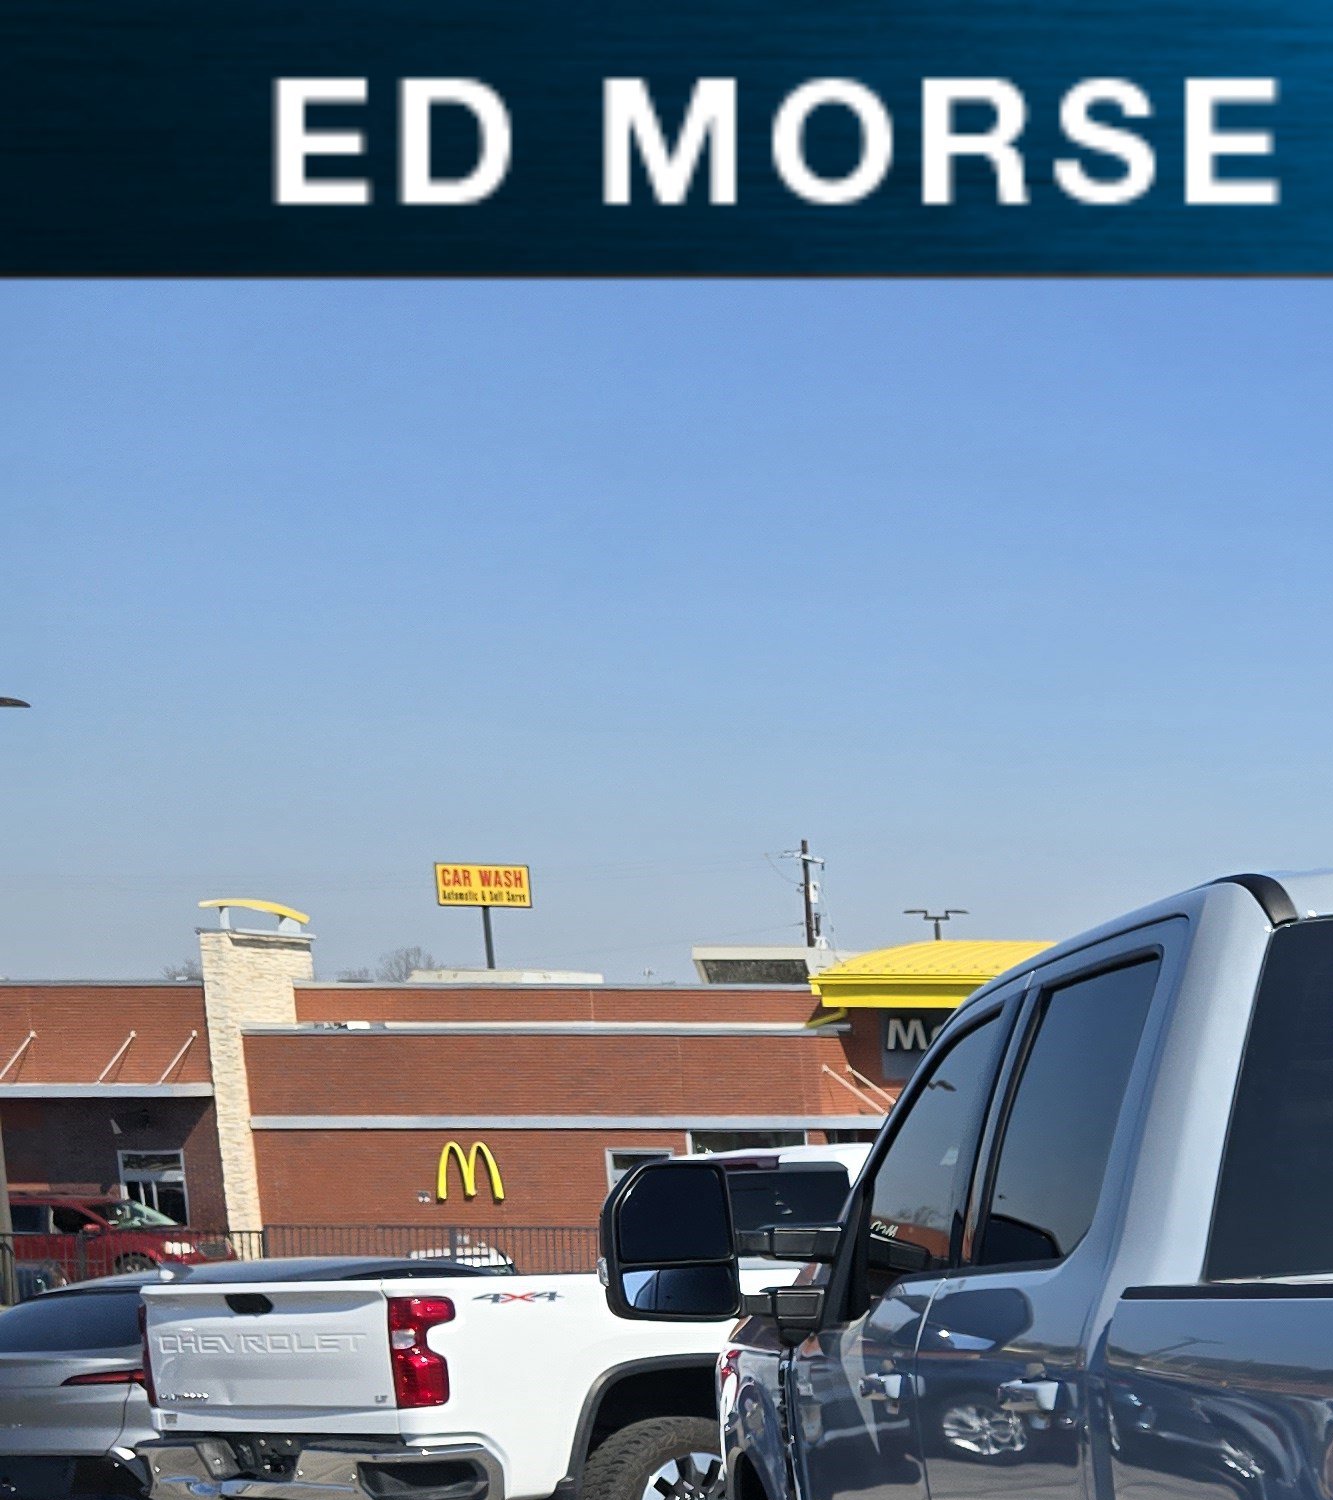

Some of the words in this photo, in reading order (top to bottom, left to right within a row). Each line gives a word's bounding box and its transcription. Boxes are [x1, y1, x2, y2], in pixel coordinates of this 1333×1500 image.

[441, 868, 472, 887] CAR
[478, 869, 524, 889] WASH
[442, 889, 479, 902] Automatic
[158, 1332, 368, 1355] CHEVROLET
